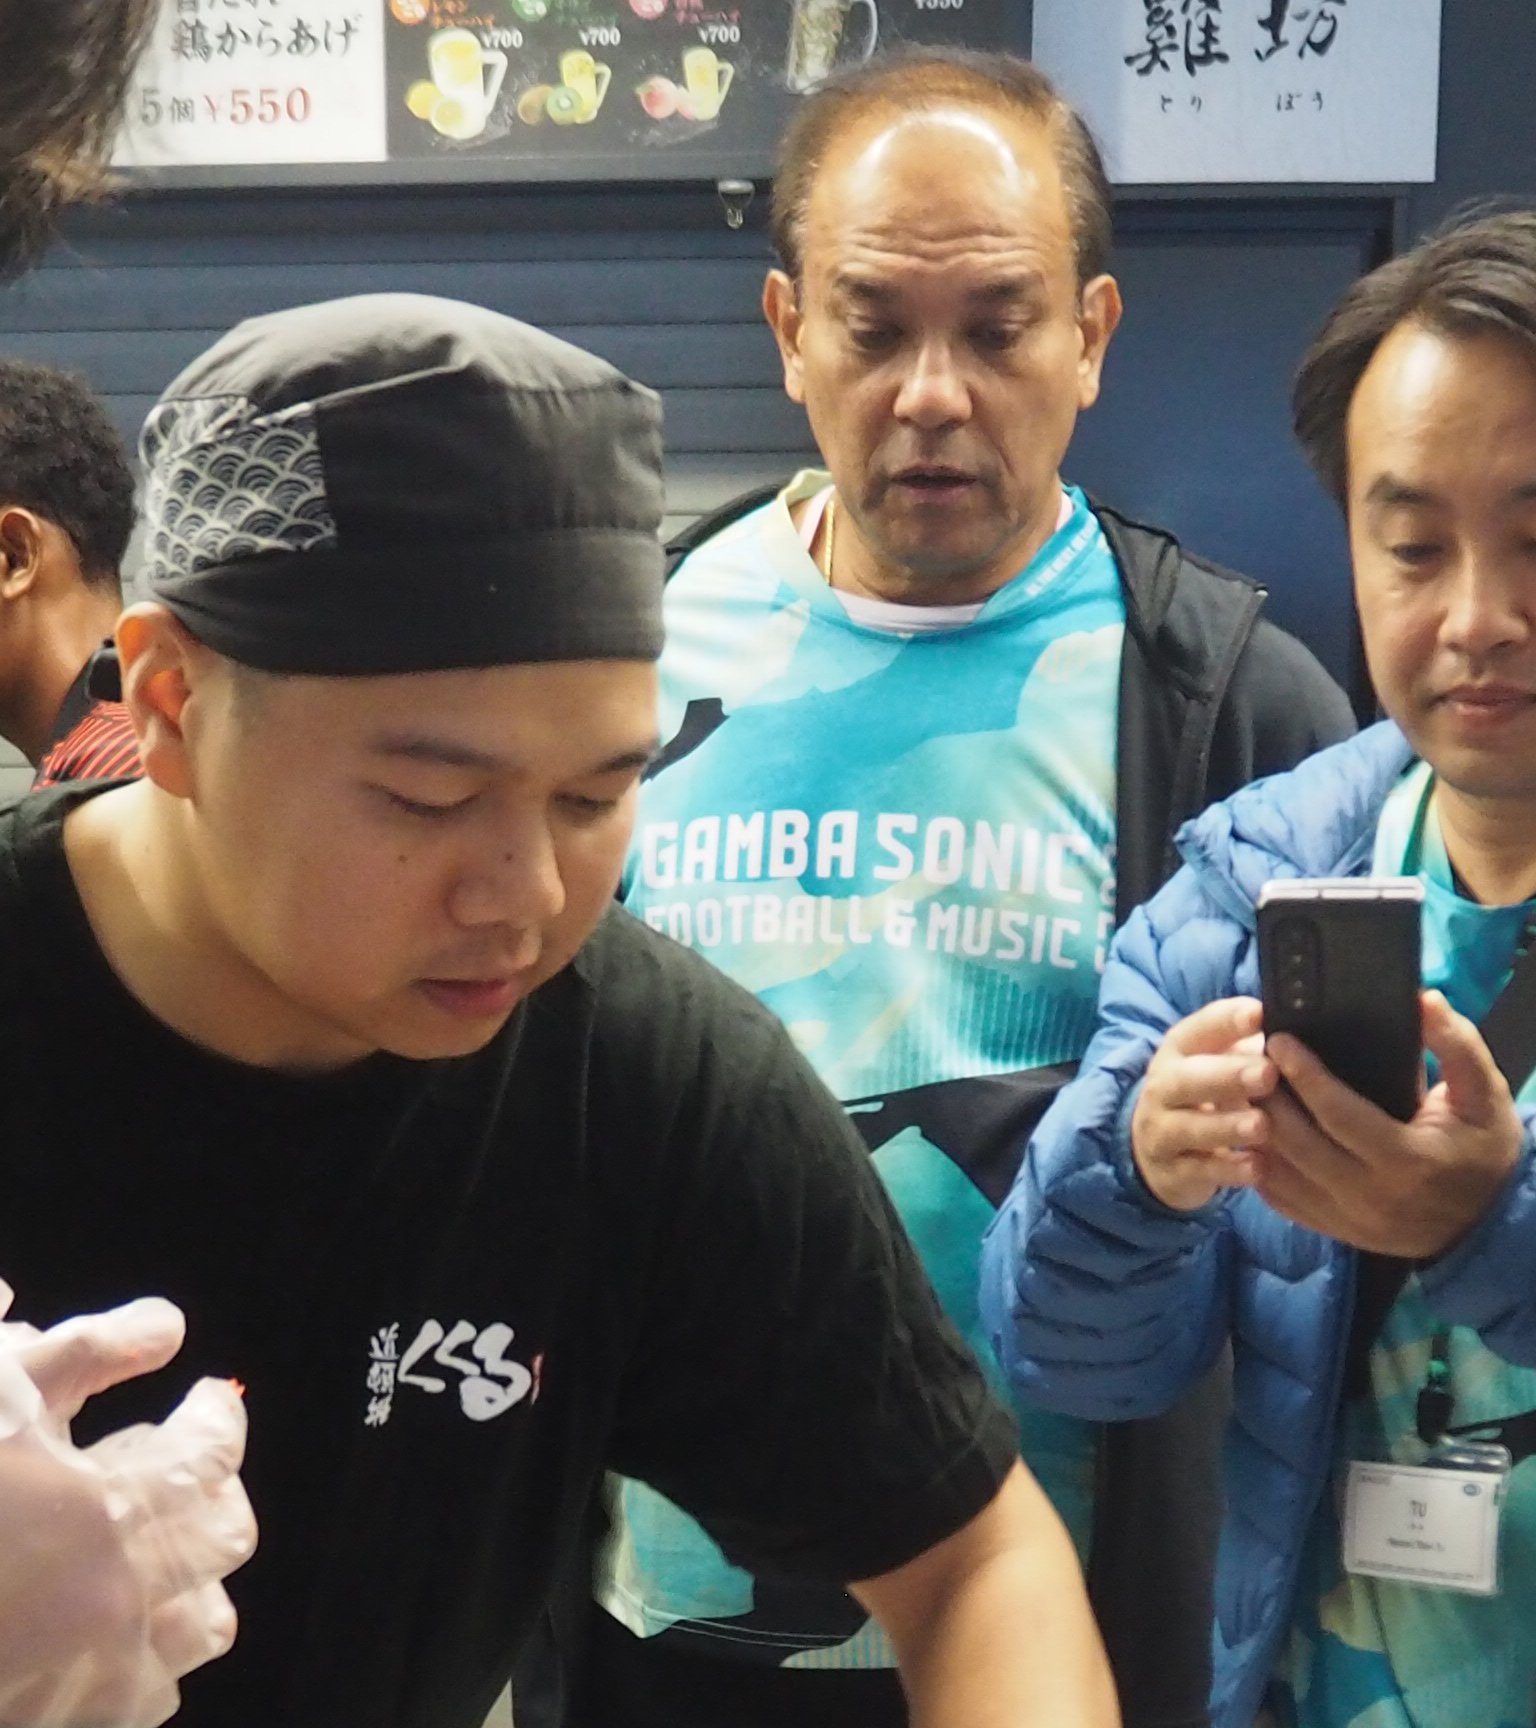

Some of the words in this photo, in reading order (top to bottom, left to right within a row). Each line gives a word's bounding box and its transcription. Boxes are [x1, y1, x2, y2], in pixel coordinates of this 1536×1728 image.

[641, 809, 860, 890] GAMBA
[873, 812, 1086, 906] SONIC
[644, 894, 872, 948] FOOTBALL
[883, 901, 918, 949] &
[926, 901, 1083, 971] MUSIC
